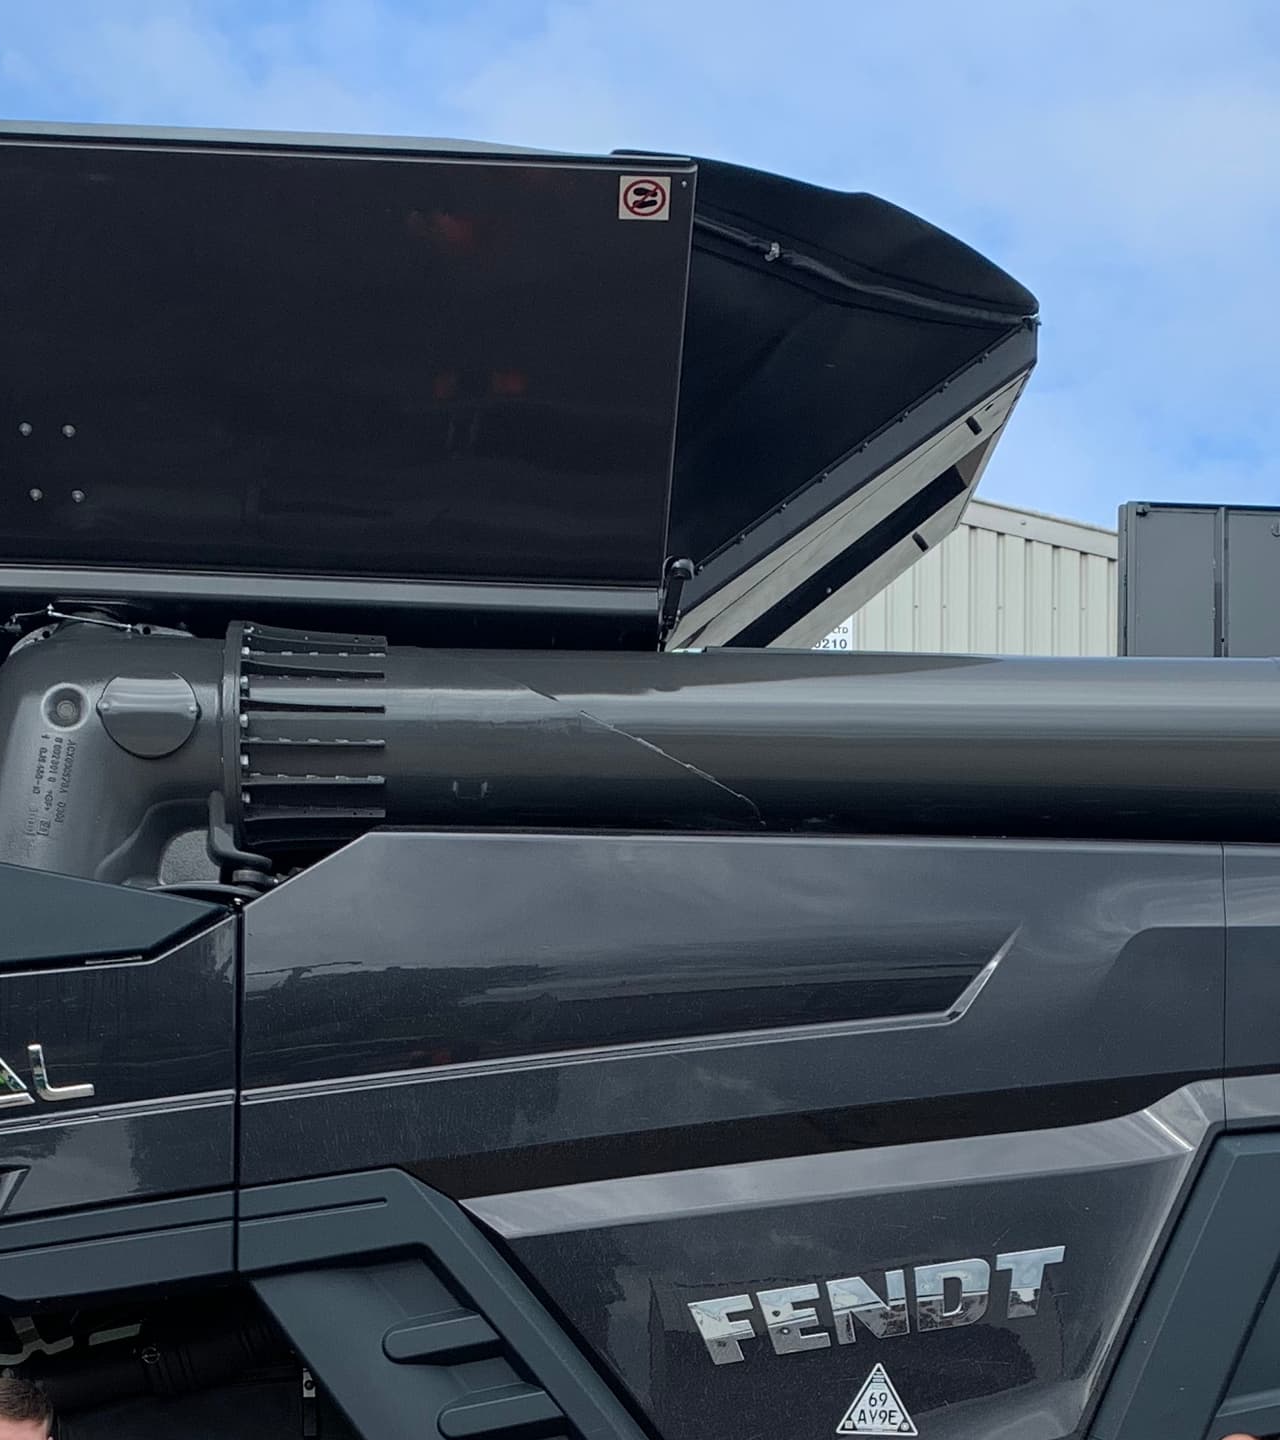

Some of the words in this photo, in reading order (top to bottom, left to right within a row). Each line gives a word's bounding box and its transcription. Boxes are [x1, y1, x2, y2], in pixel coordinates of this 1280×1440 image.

[687, 1245, 1067, 1366] FENDT
[869, 1392, 888, 1407] 69
[858, 1409, 898, 1426] AY9E
